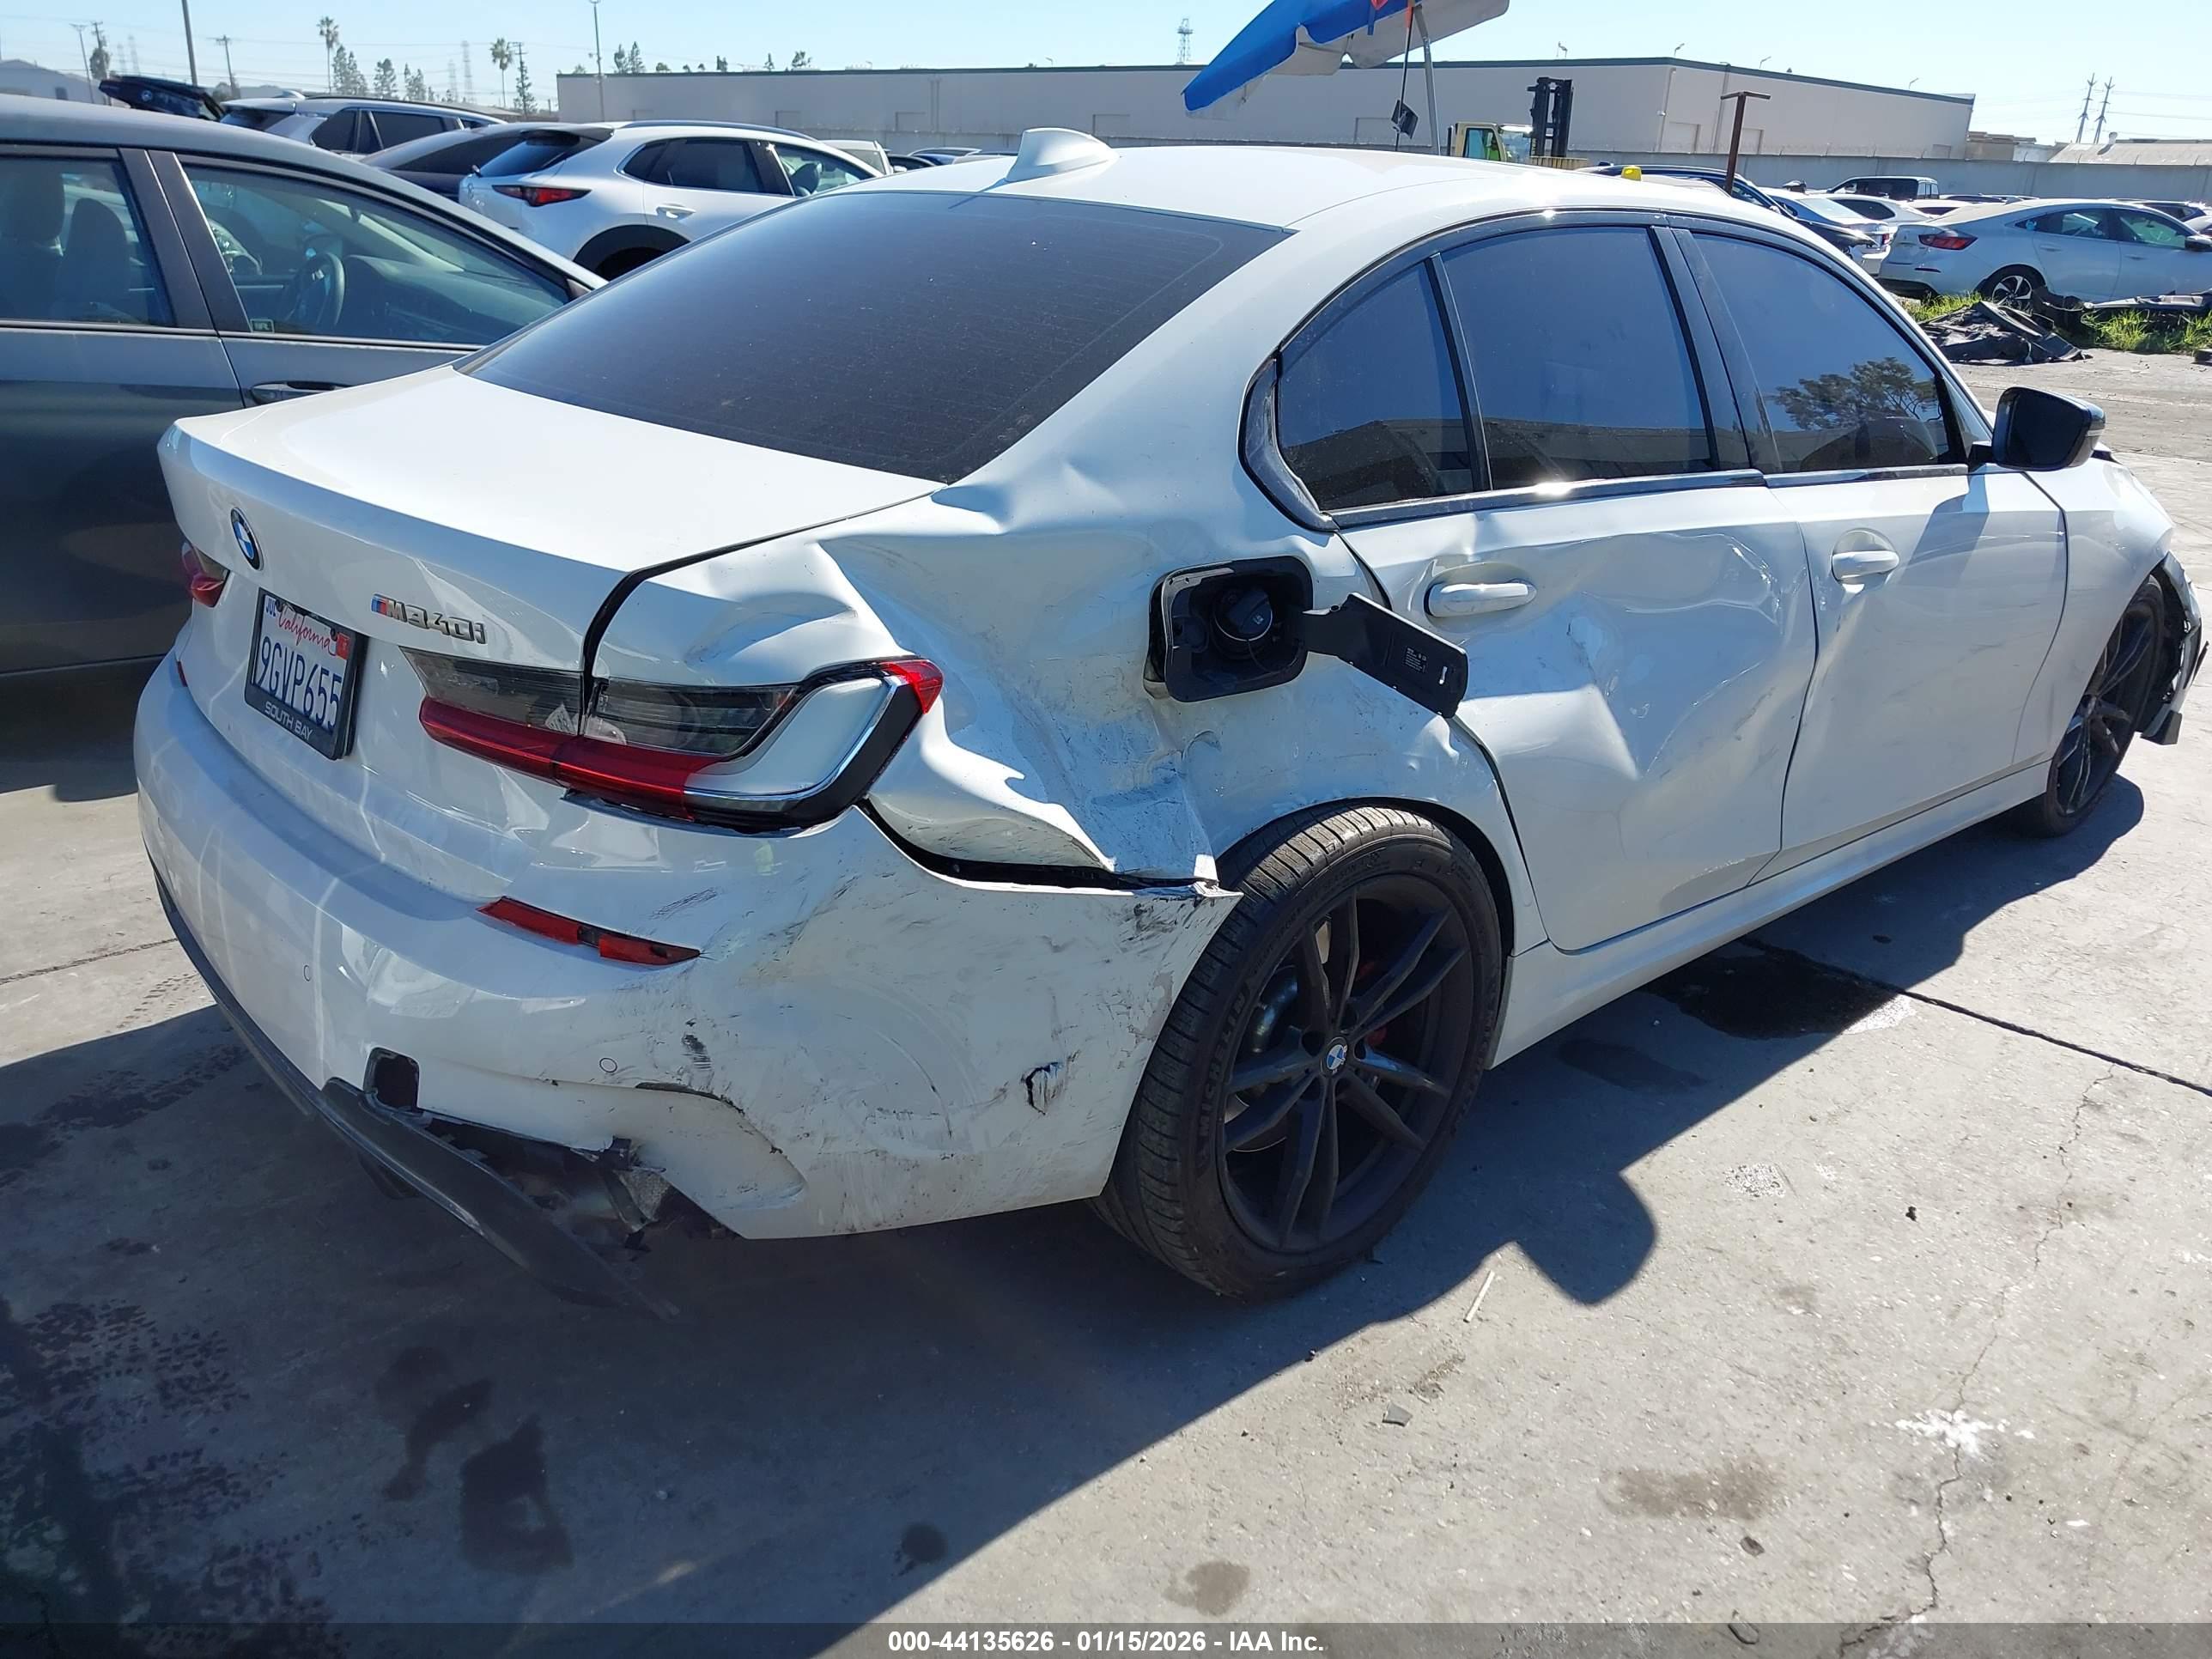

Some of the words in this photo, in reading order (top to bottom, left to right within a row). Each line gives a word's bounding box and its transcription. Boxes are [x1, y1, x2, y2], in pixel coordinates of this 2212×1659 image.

[277, 604, 337, 657] California
[385, 598, 487, 645] M340i
[259, 635, 343, 732] 9GVP655
[264, 701, 295, 729] SOUTH
[295, 719, 313, 741] BAY
